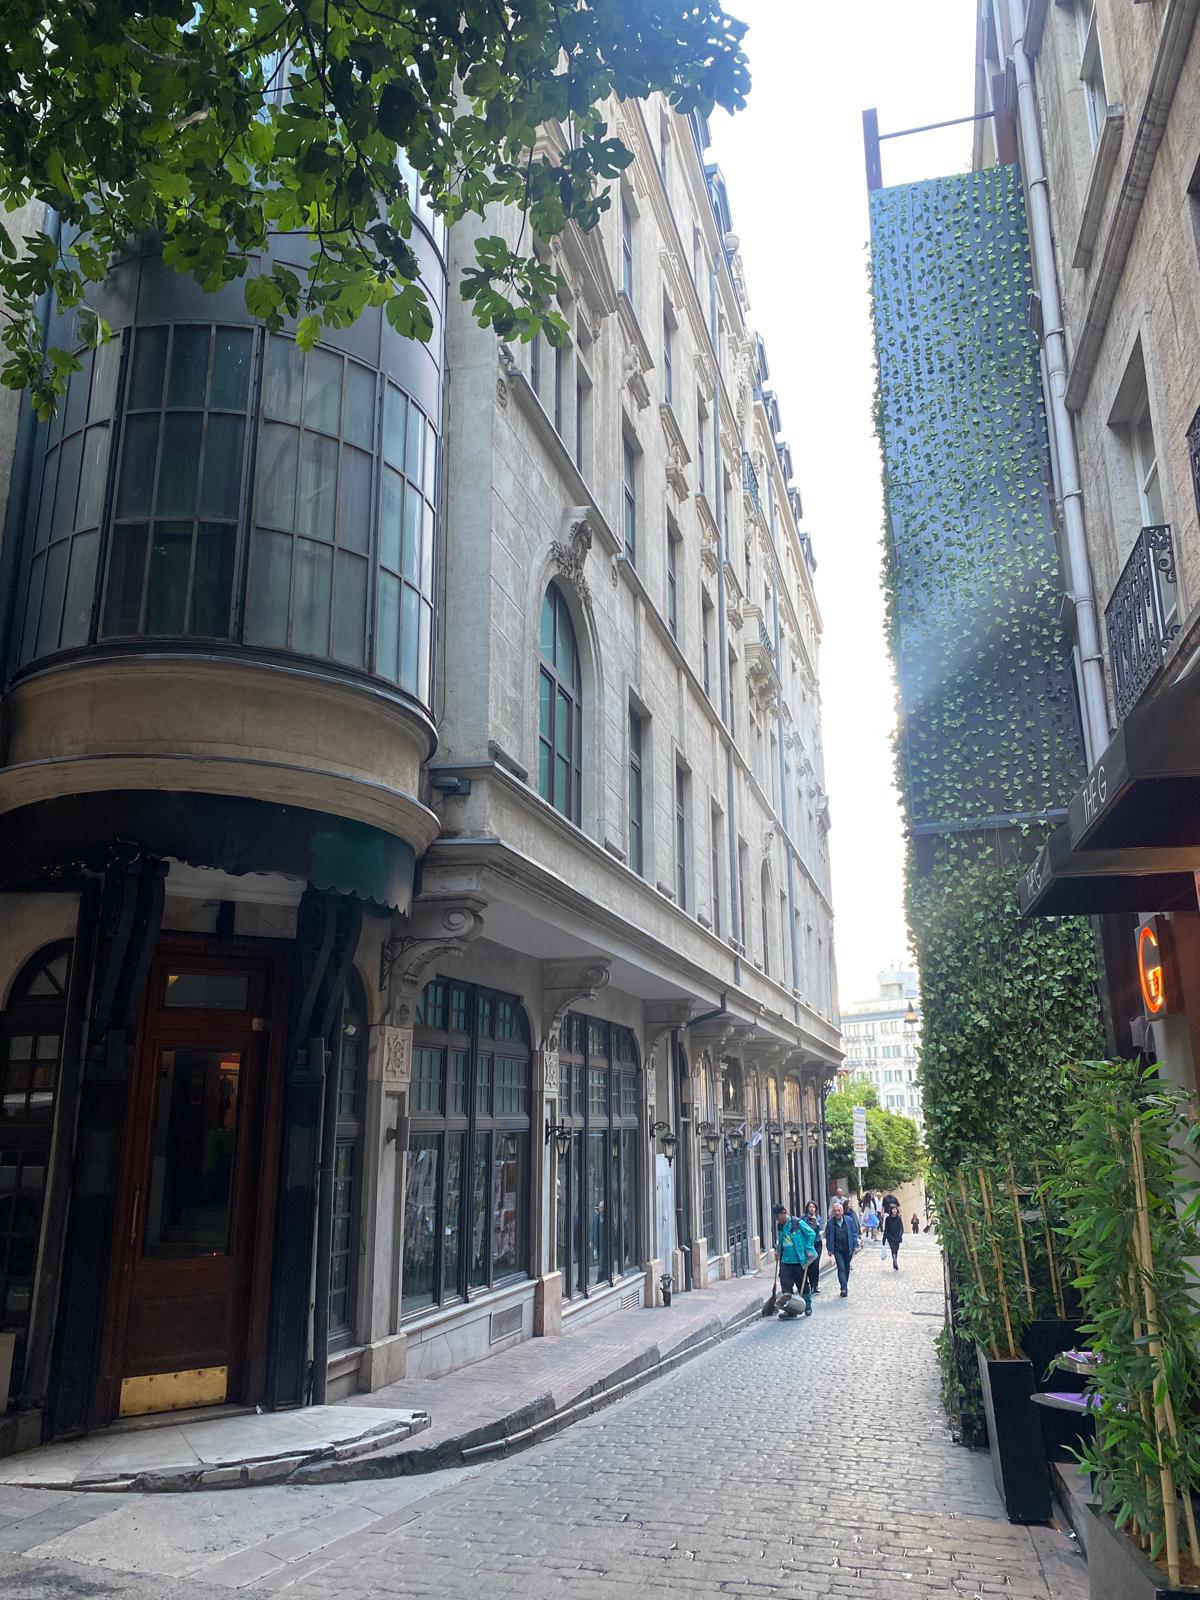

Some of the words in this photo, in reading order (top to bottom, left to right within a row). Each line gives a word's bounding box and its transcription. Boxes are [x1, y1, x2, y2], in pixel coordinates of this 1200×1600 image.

[1083, 777, 1098, 825] THE
[1098, 765, 1107, 804] G
[1138, 927, 1163, 1013] G
